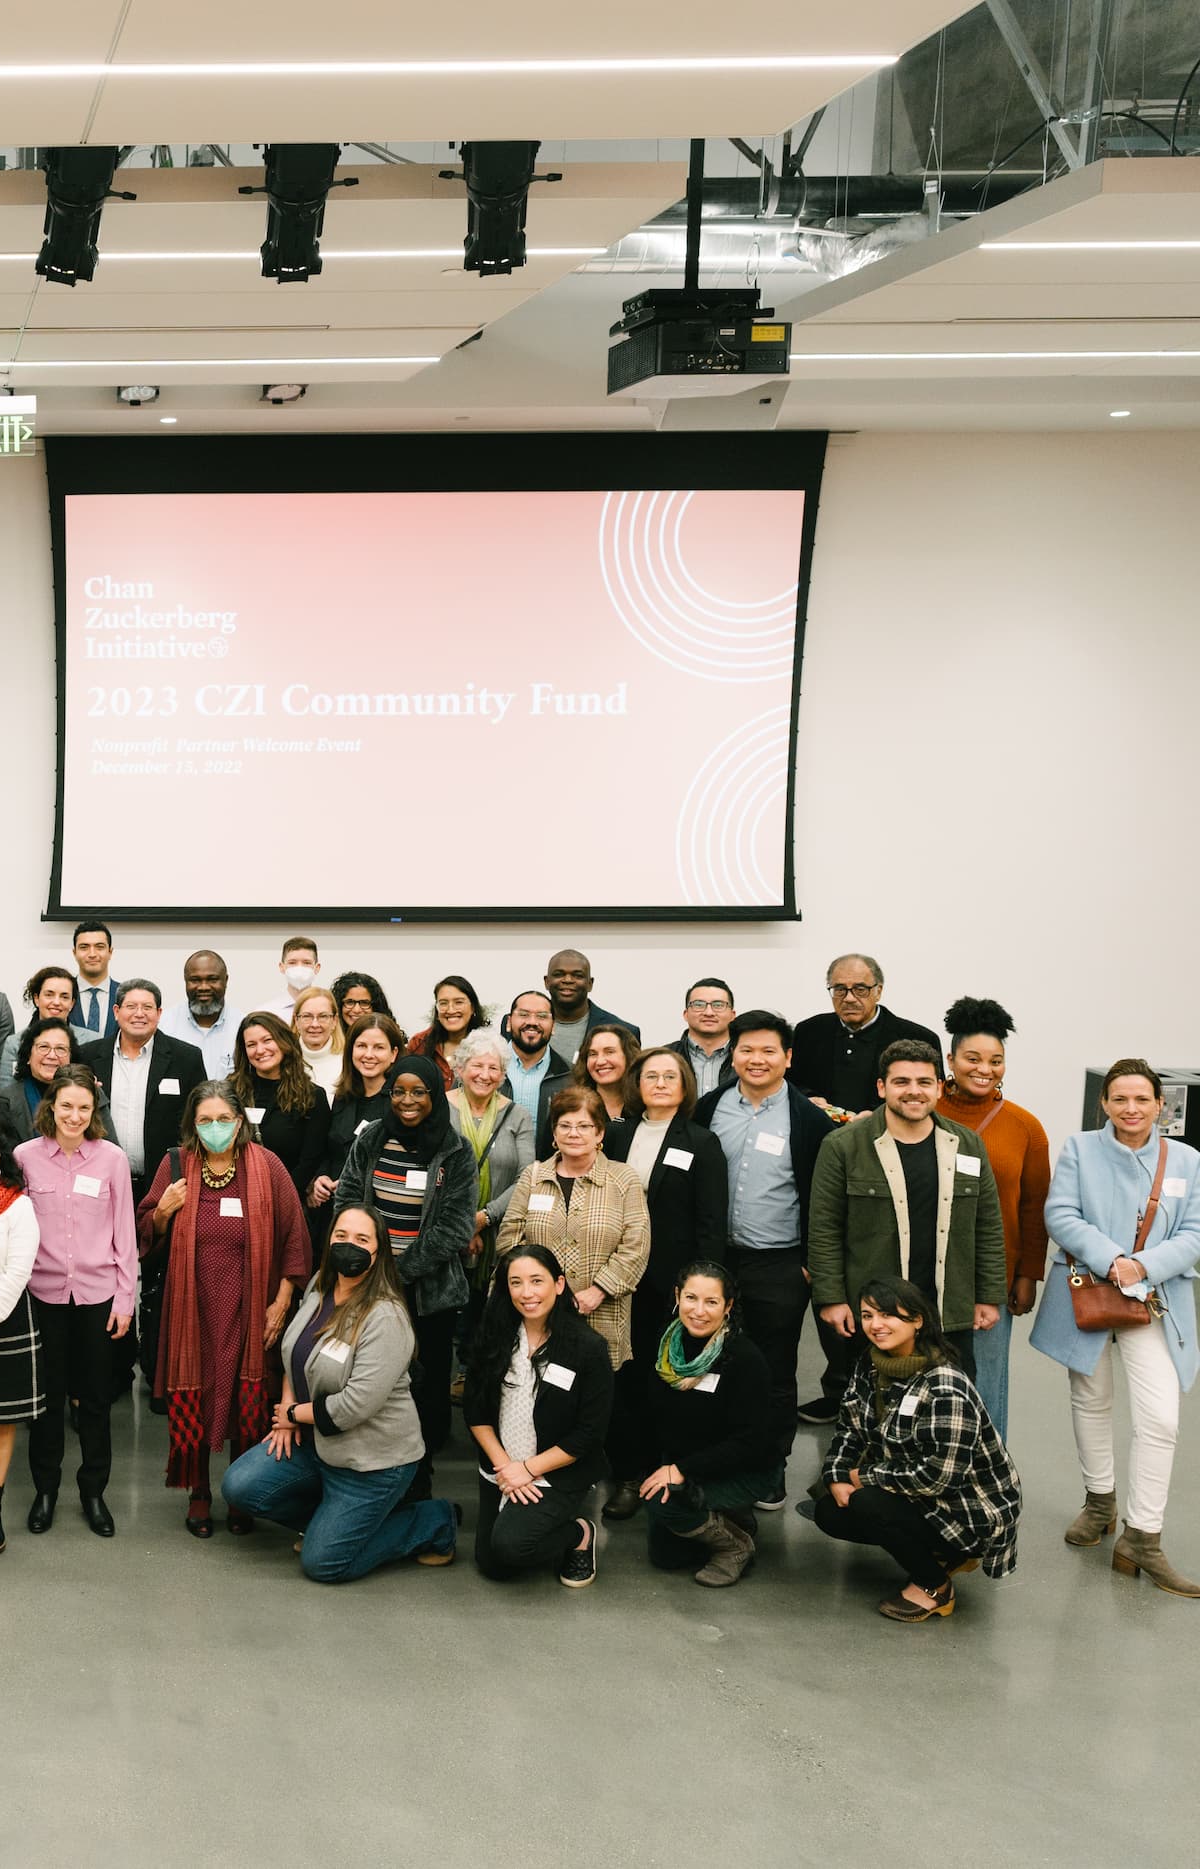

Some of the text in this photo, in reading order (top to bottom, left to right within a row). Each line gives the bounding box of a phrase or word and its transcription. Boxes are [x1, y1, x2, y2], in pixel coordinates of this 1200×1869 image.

[84, 574, 155, 599] Chan
[84, 603, 239, 633] Zuckerberg
[84, 634, 206, 659] Initiative
[87, 681, 627, 724] 2023 CZI Community Fund
[90, 735, 362, 758] Nonprofit Partner Welcome Event
[91, 758, 170, 775] December
[202, 759, 243, 774] 2022
